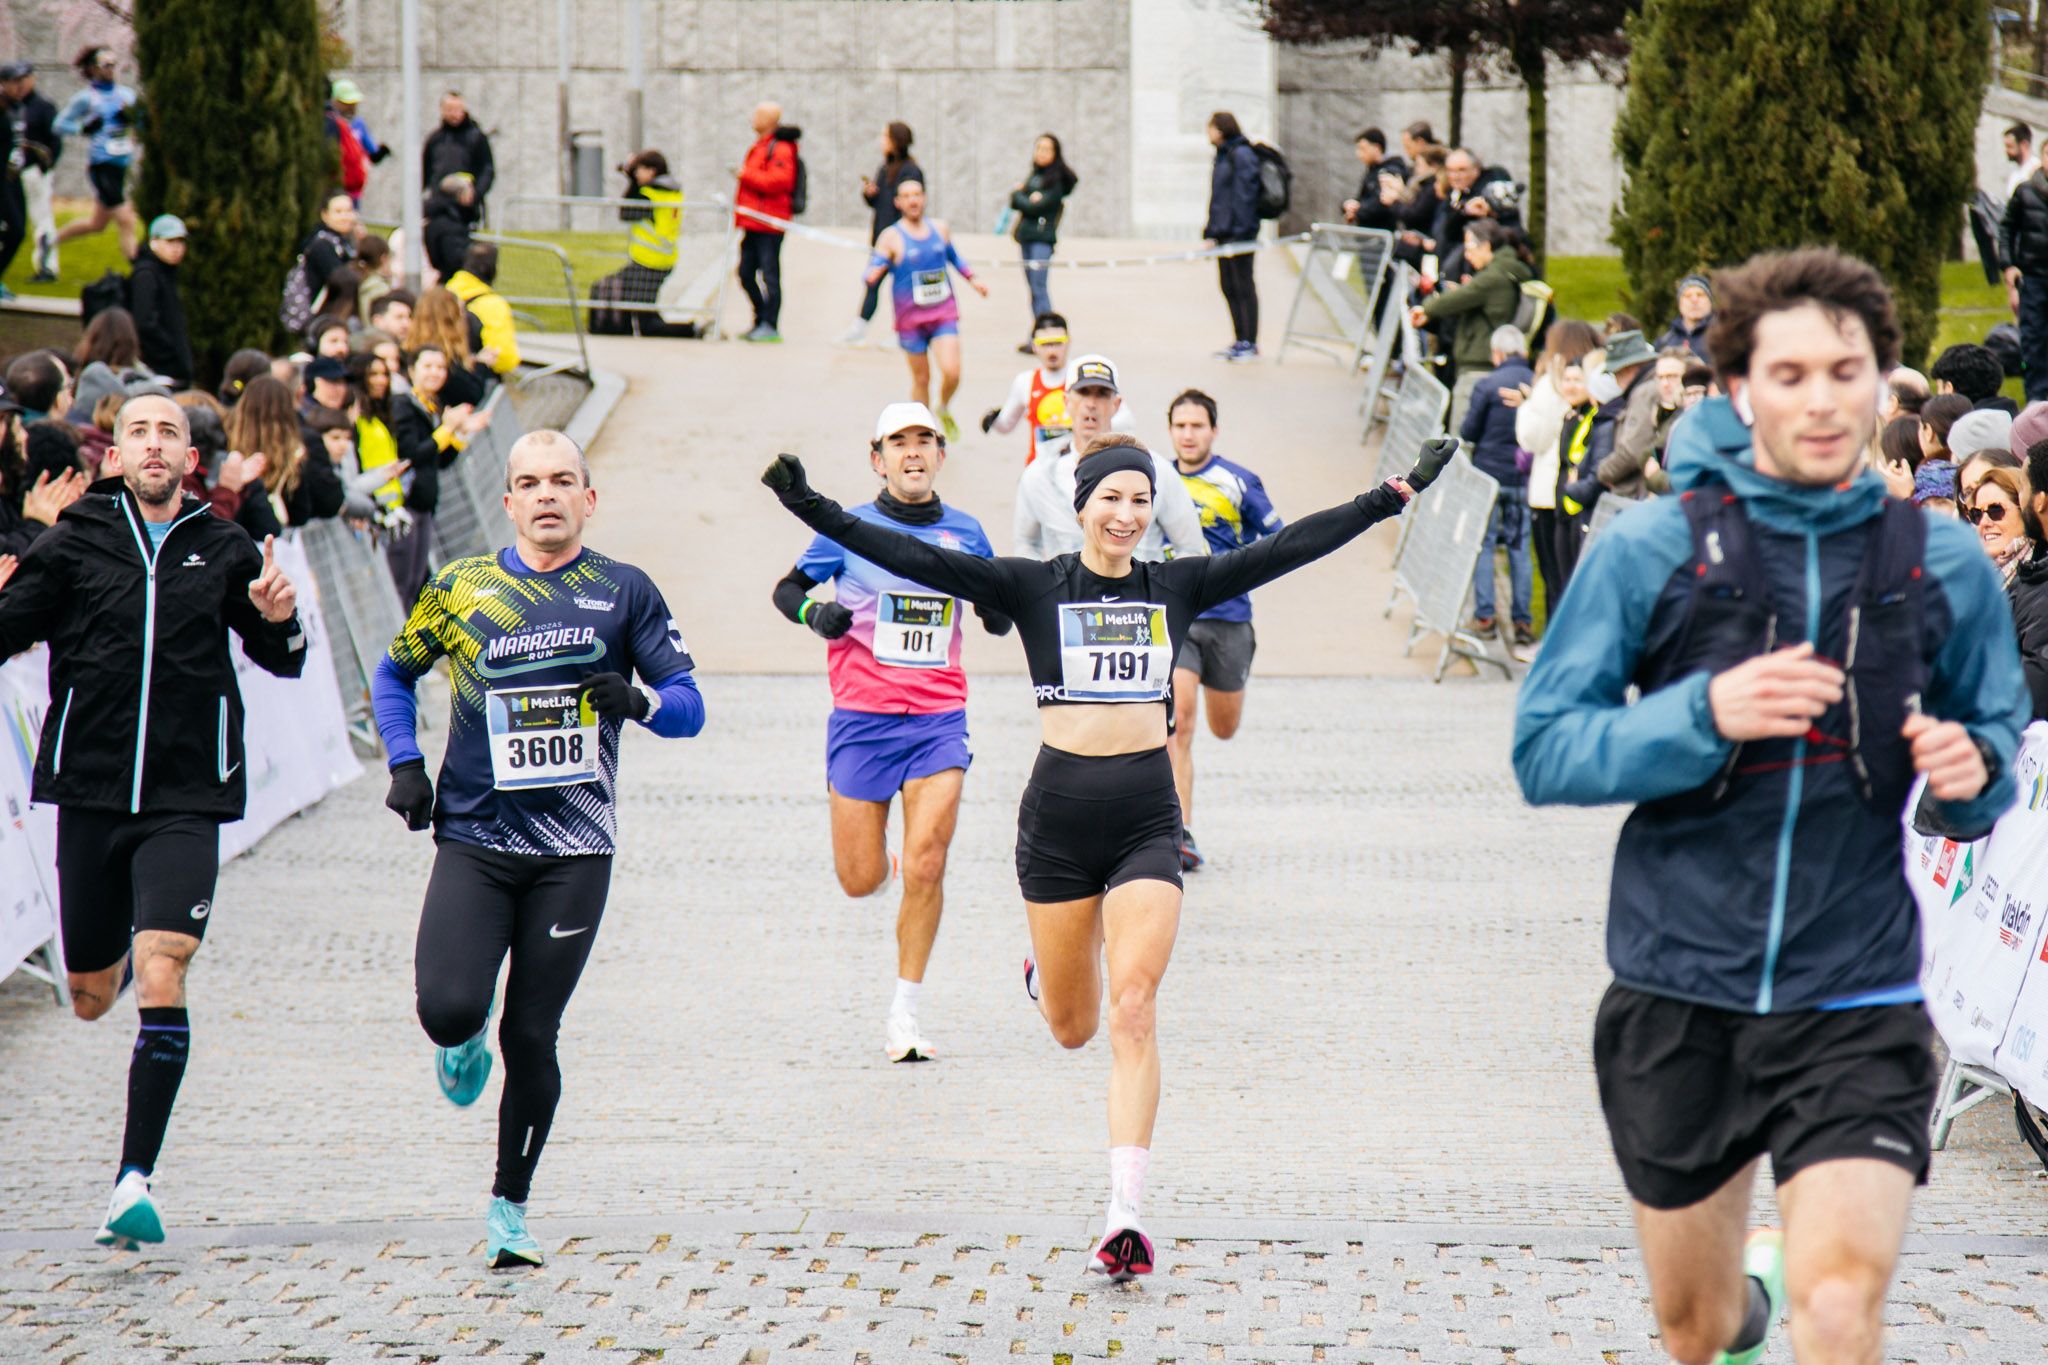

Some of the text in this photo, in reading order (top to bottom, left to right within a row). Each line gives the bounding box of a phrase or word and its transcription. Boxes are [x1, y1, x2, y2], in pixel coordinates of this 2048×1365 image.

[911, 600, 943, 611] MetLife
[1105, 613, 1147, 625] MetLife
[516, 621, 562, 634] LAS ROZAS
[488, 627, 595, 660] MARAZUELA
[901, 630, 933, 652] 101
[528, 649, 554, 661] RUN
[1089, 652, 1149, 681] 7191
[531, 696, 577, 709] MetLife
[508, 734, 583, 768] 3608
